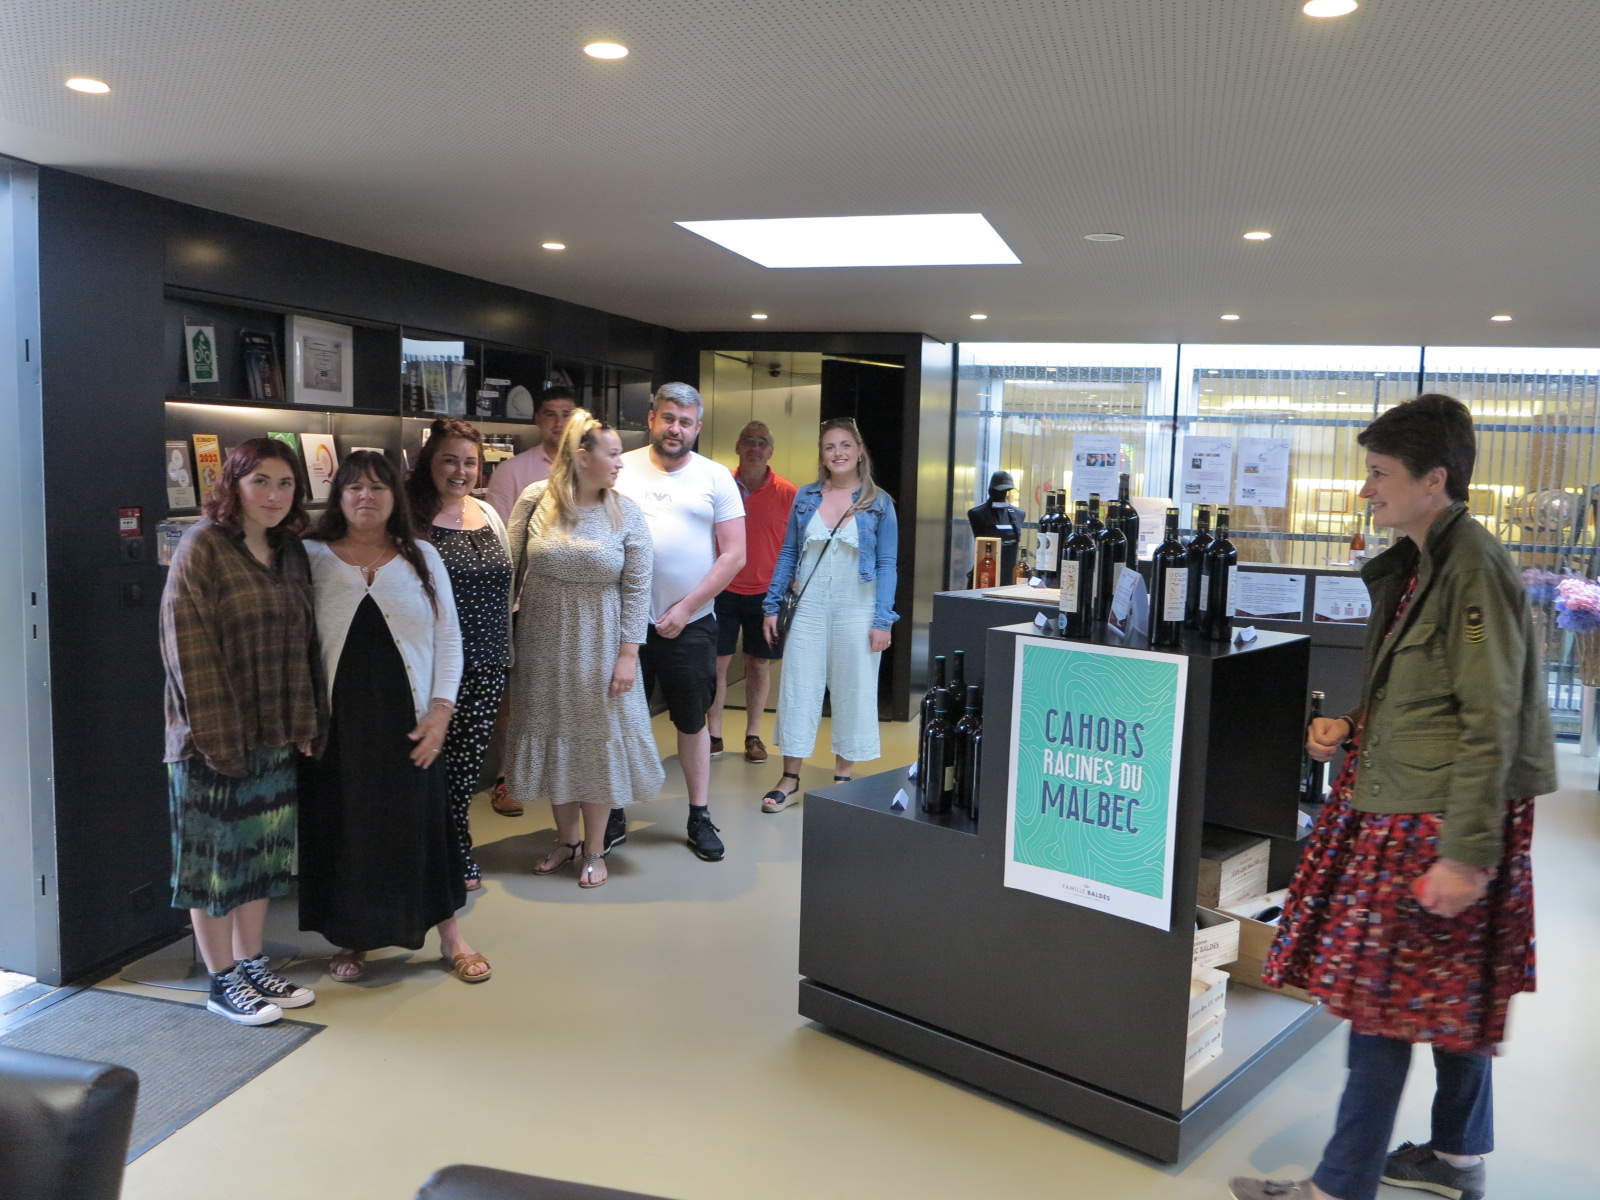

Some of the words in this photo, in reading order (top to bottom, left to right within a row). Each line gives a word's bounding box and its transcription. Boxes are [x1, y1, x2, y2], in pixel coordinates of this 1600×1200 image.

[199, 453, 218, 463] 2023
[1045, 708, 1146, 759] CAHORS
[1043, 748, 1114, 786] RACINES
[1120, 762, 1143, 792] DU
[1041, 780, 1140, 834] MALBEC
[1062, 883, 1086, 895] FAMILLE
